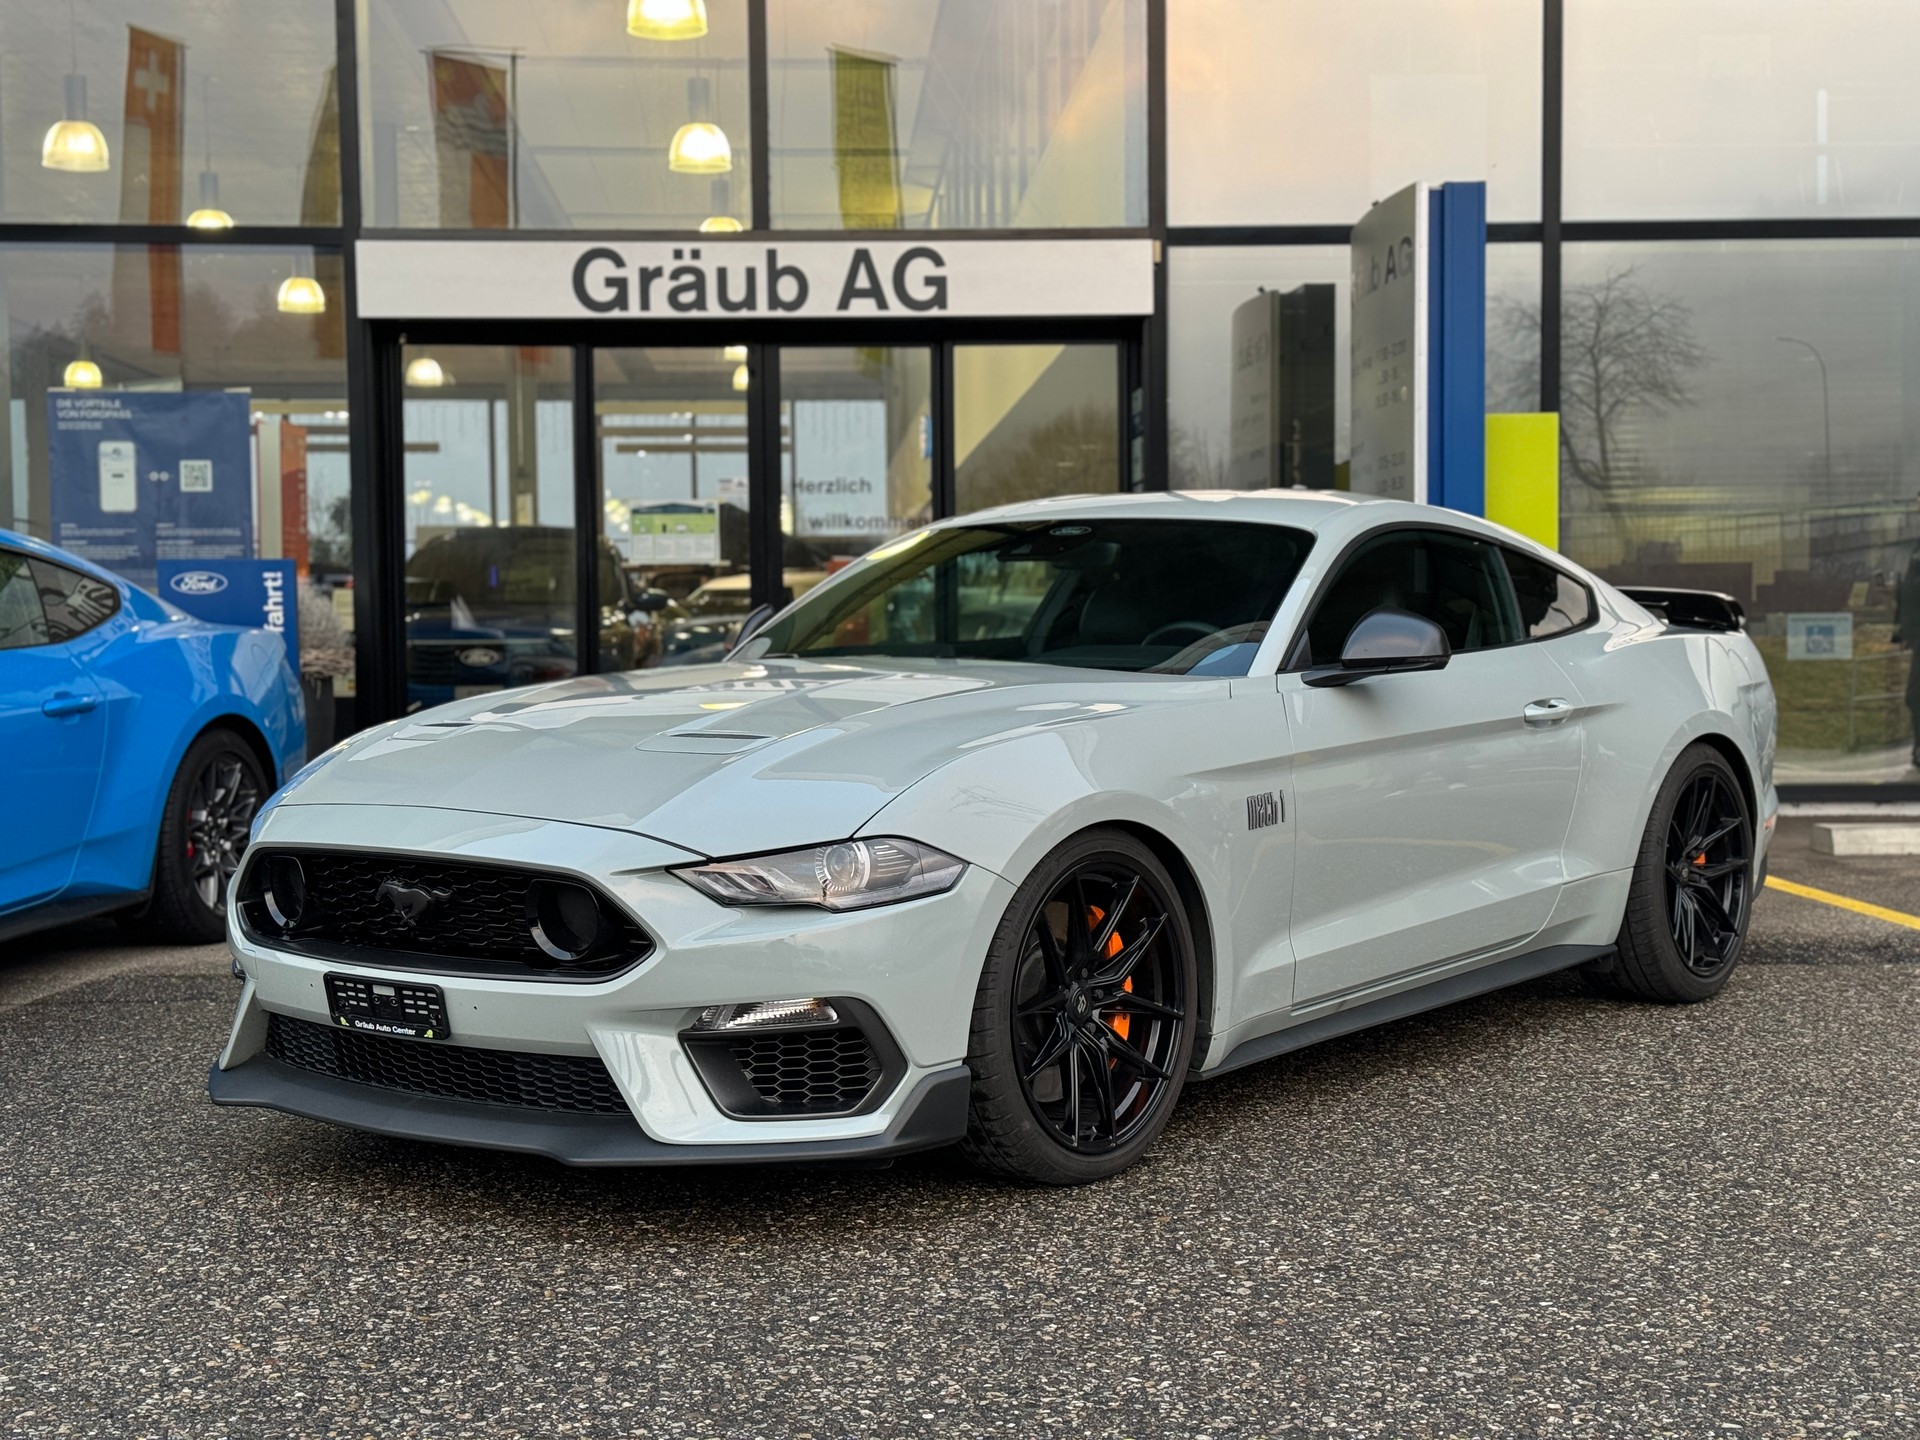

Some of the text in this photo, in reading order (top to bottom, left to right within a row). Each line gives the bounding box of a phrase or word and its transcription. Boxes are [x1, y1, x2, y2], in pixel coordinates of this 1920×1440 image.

[572, 247, 948, 313] Gräub AG
[792, 476, 872, 494] Herzlich
[808, 513, 930, 530] willkommen
[376, 1023, 392, 1033] Auto
[392, 1026, 416, 1036] Center
